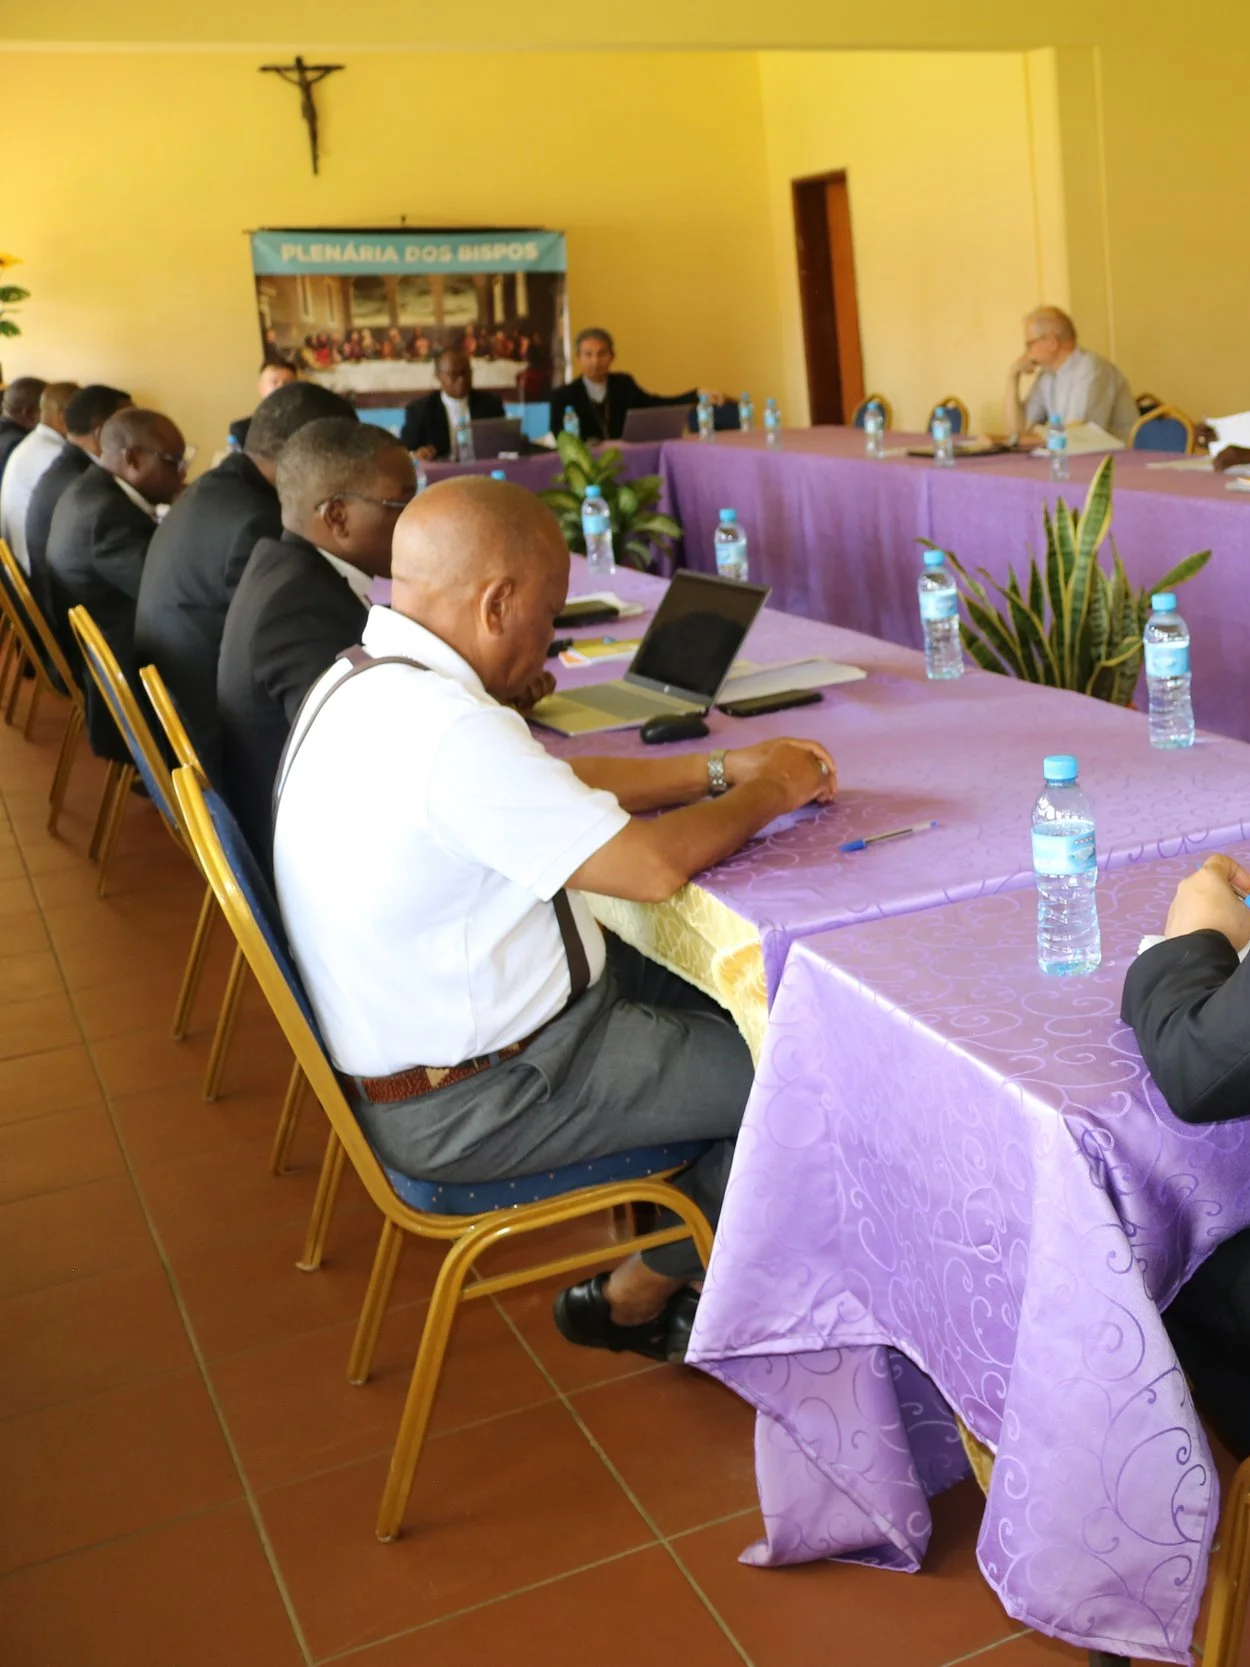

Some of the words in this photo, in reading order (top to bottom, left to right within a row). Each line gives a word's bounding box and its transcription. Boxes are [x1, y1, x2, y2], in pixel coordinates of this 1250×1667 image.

[281, 241, 398, 263] PLENÁRIA
[404, 245, 451, 263] DOS
[458, 242, 538, 262] BISPOS
